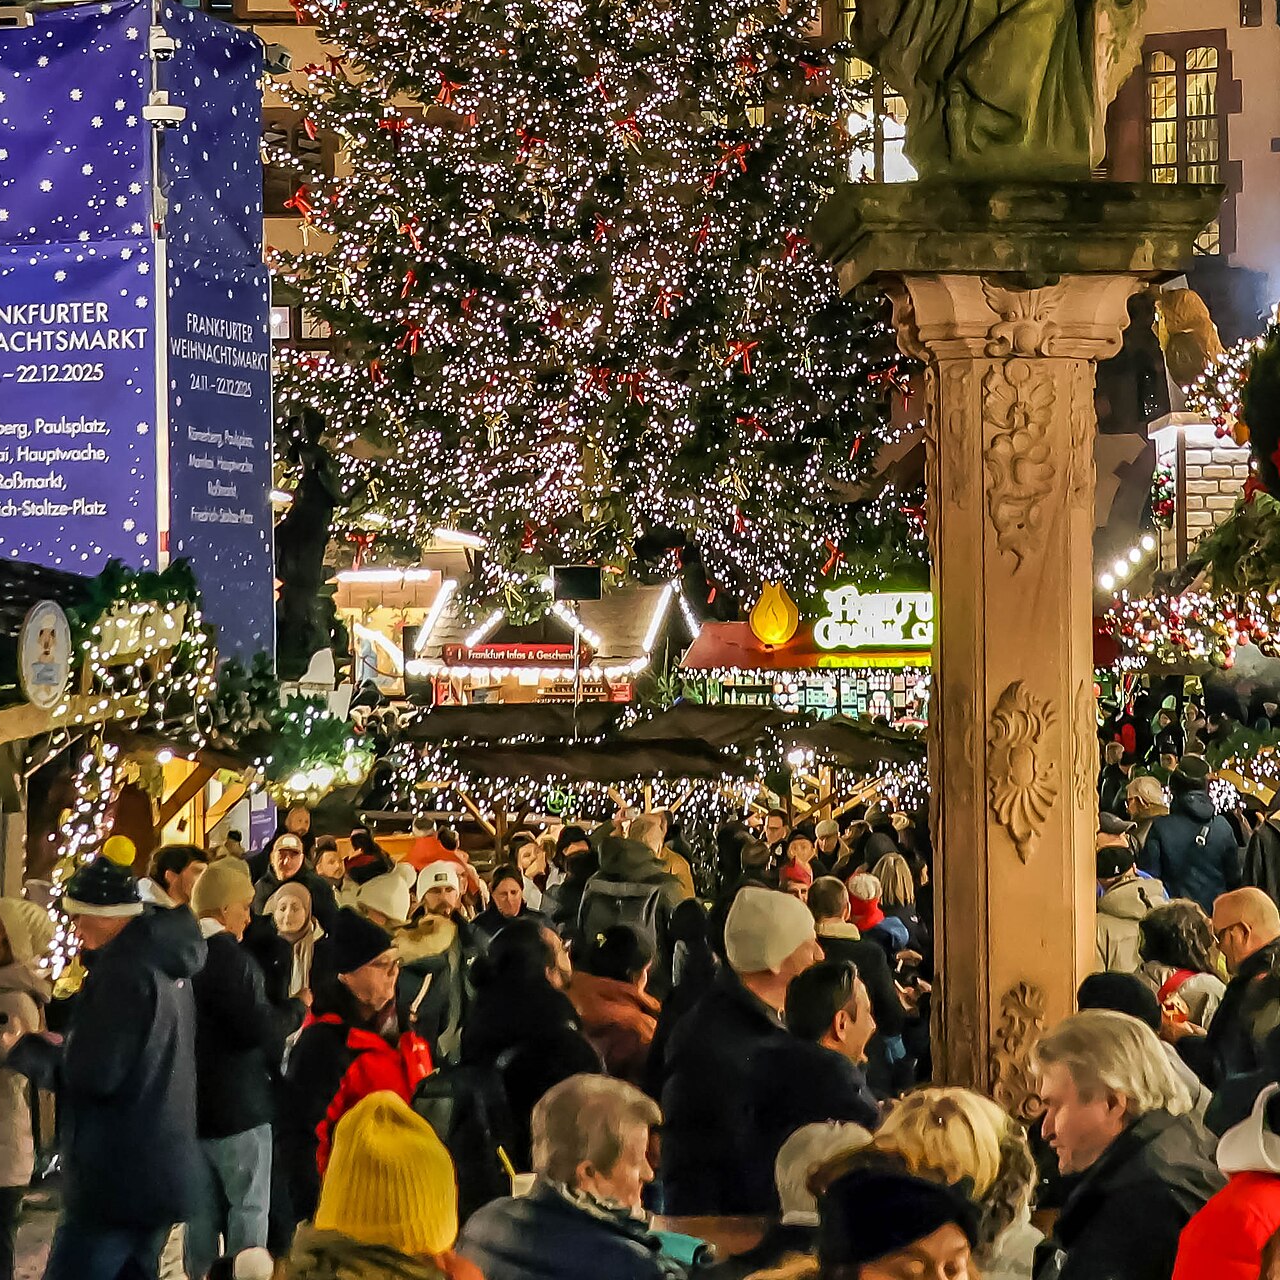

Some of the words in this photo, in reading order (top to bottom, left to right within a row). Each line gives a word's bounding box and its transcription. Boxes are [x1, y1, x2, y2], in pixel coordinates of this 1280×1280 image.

[186, 312, 254, 343] FRANKFURTER
[170, 336, 268, 371] WEIHNACHTSMARKT
[16, 363, 104, 384] 22.12.2025
[35, 415, 111, 439] Paulsplatz,
[16, 443, 110, 466] Hauptwache,
[468, 649, 506, 660] Frankfurt
[506, 649, 526, 660] Infos
[527, 650, 535, 660] &
[536, 650, 578, 661] Geschenk
